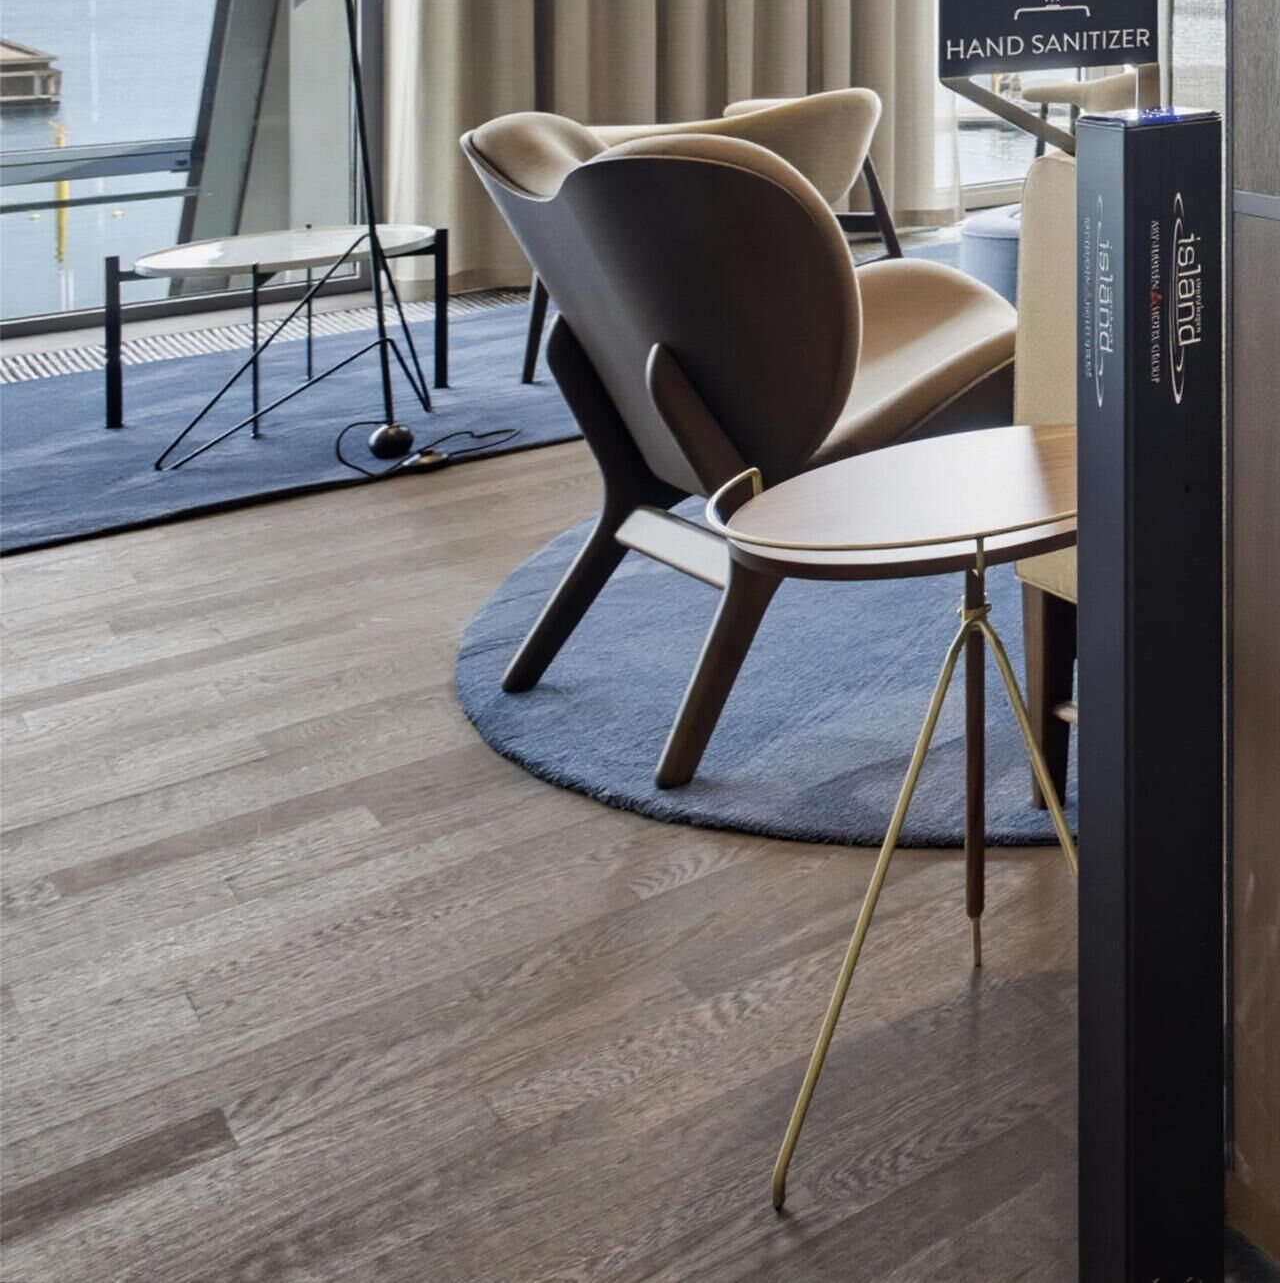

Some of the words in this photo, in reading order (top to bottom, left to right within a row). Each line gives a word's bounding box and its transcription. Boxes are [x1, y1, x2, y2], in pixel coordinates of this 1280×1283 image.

[946, 36, 1025, 60] HAND
[1031, 28, 1150, 55] SANITIZER
[1099, 240, 1113, 353] island
[1178, 233, 1201, 346] island
